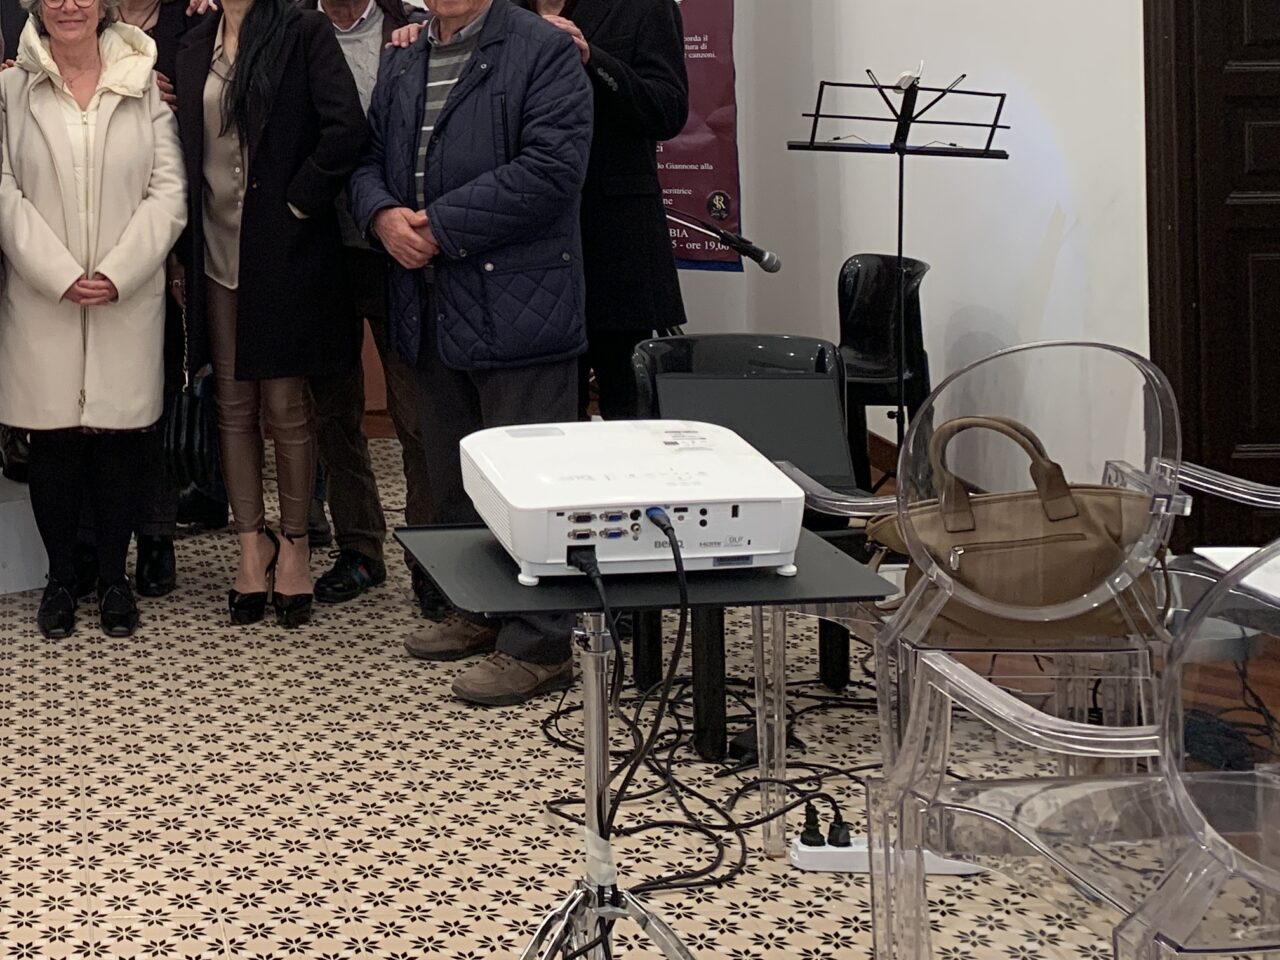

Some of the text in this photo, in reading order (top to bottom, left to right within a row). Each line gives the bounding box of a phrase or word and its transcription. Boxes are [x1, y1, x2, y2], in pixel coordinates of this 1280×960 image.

[666, 162, 699, 170] Giannone
[700, 162, 714, 170] alla
[669, 229, 689, 238] BIA
[672, 240, 677, 249] 5
[685, 242, 702, 250] ore
